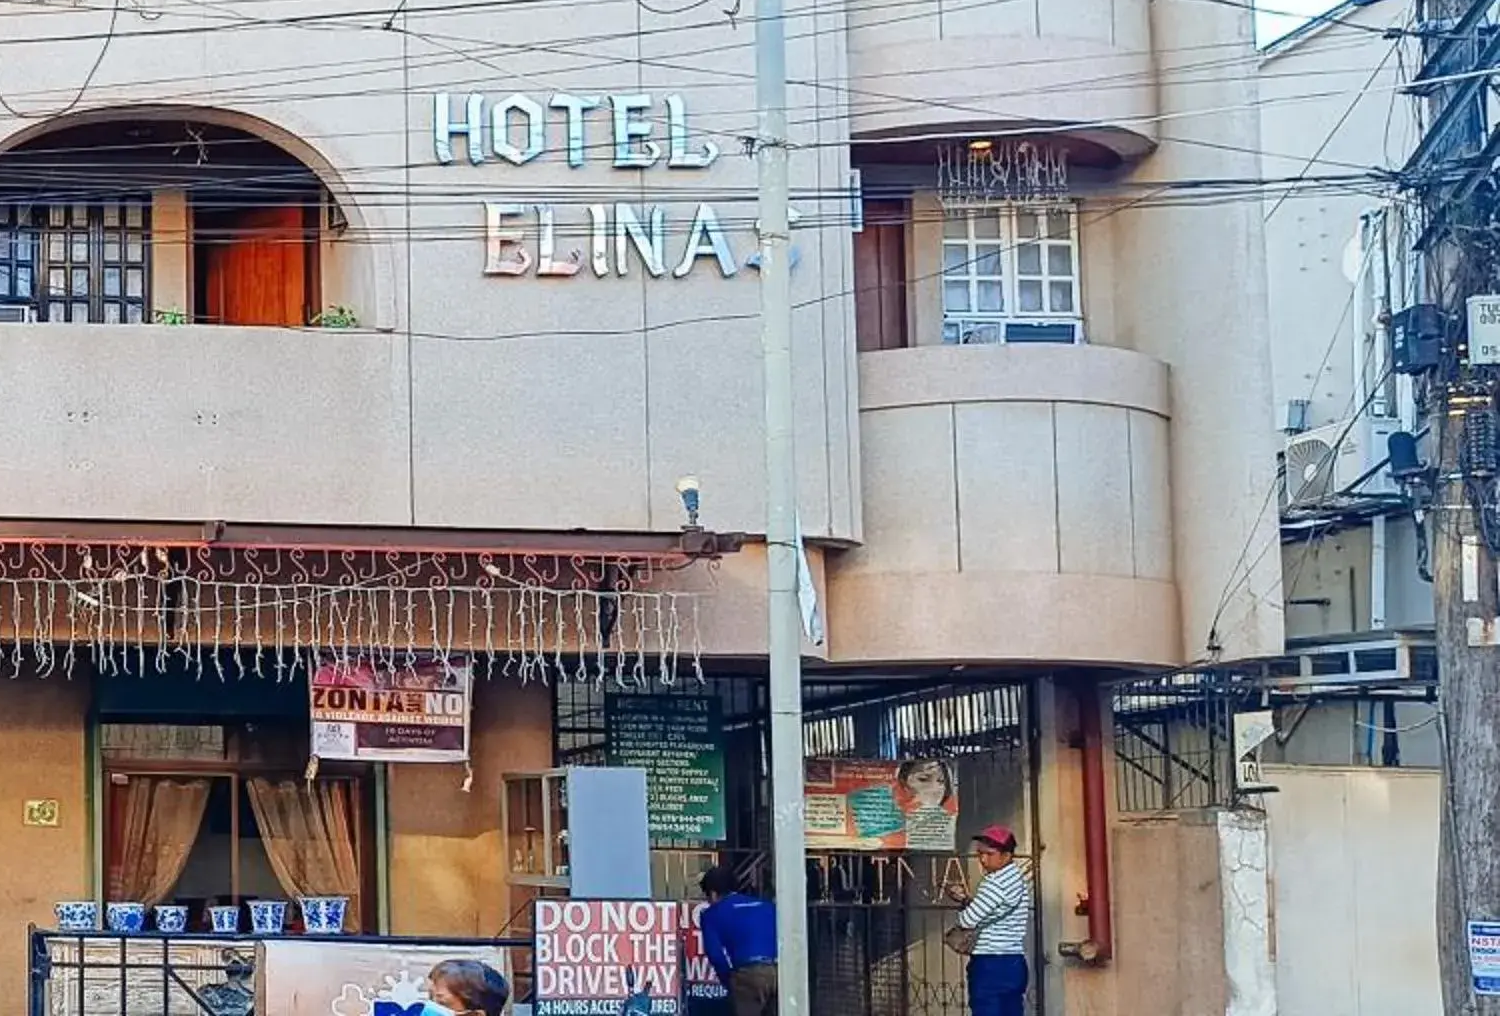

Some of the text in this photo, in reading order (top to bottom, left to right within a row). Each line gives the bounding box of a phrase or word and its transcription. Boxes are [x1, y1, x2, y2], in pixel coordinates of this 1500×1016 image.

[433, 91, 720, 169] HOTEL
[312, 687, 403, 712] ZONTA
[425, 692, 463, 715] NO
[535, 901, 591, 932] DO
[601, 901, 677, 932] NOT
[535, 934, 677, 963] BLOCK THE
[537, 965, 677, 996] DRIVEWAY
[537, 1000, 551, 1015] 24
[553, 999, 589, 1015] HOURS
